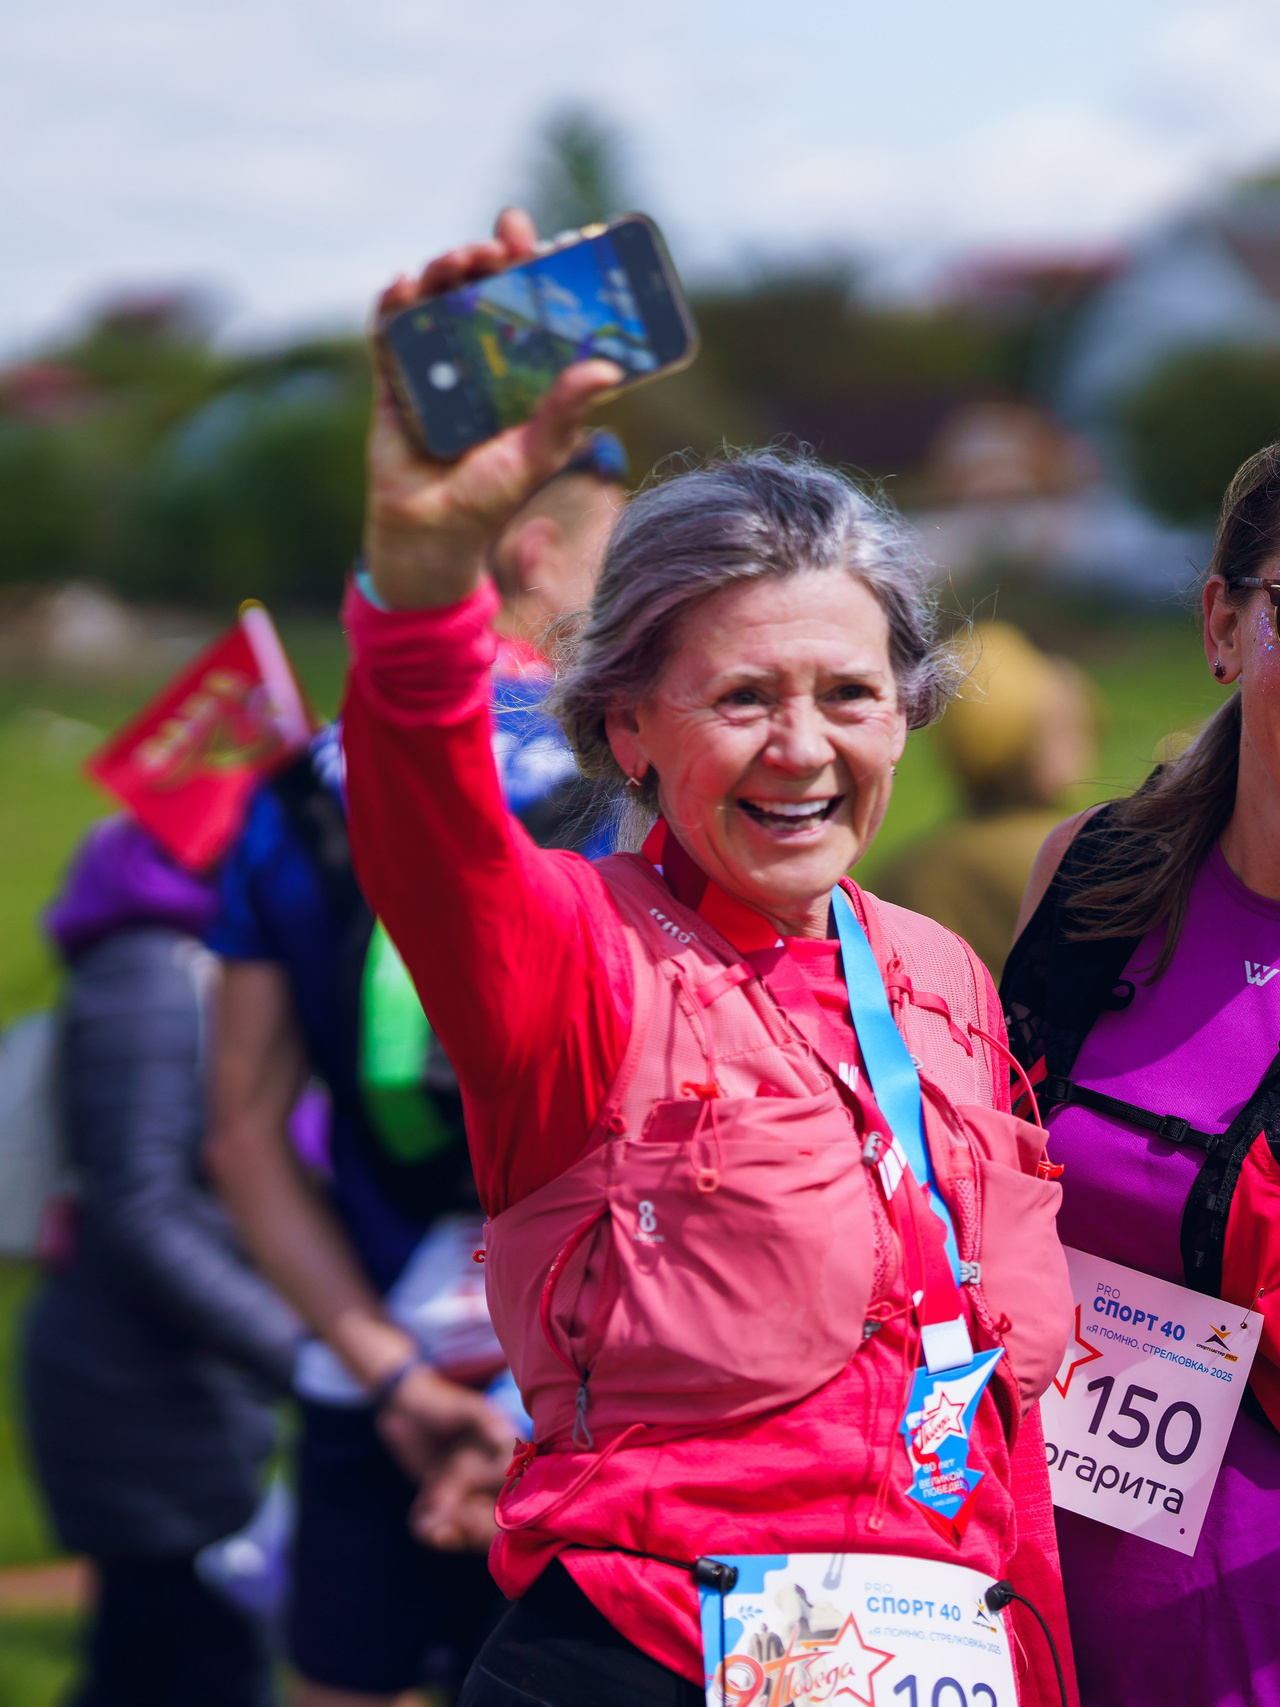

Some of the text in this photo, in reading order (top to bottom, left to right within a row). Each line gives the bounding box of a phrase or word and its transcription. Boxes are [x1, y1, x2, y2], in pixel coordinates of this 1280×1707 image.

[638, 1200, 657, 1233] 8
[1096, 1282, 1121, 1300] PRO
[1093, 1295, 1186, 1342] СПОРТ 40
[1086, 1323, 1233, 1383] «Я ПОМНЮ. СТРЕЛКОВКА» 2025
[1086, 1375, 1202, 1465] 150
[864, 1582, 893, 1594] PRO
[866, 1596, 962, 1622] СПОРТ 40
